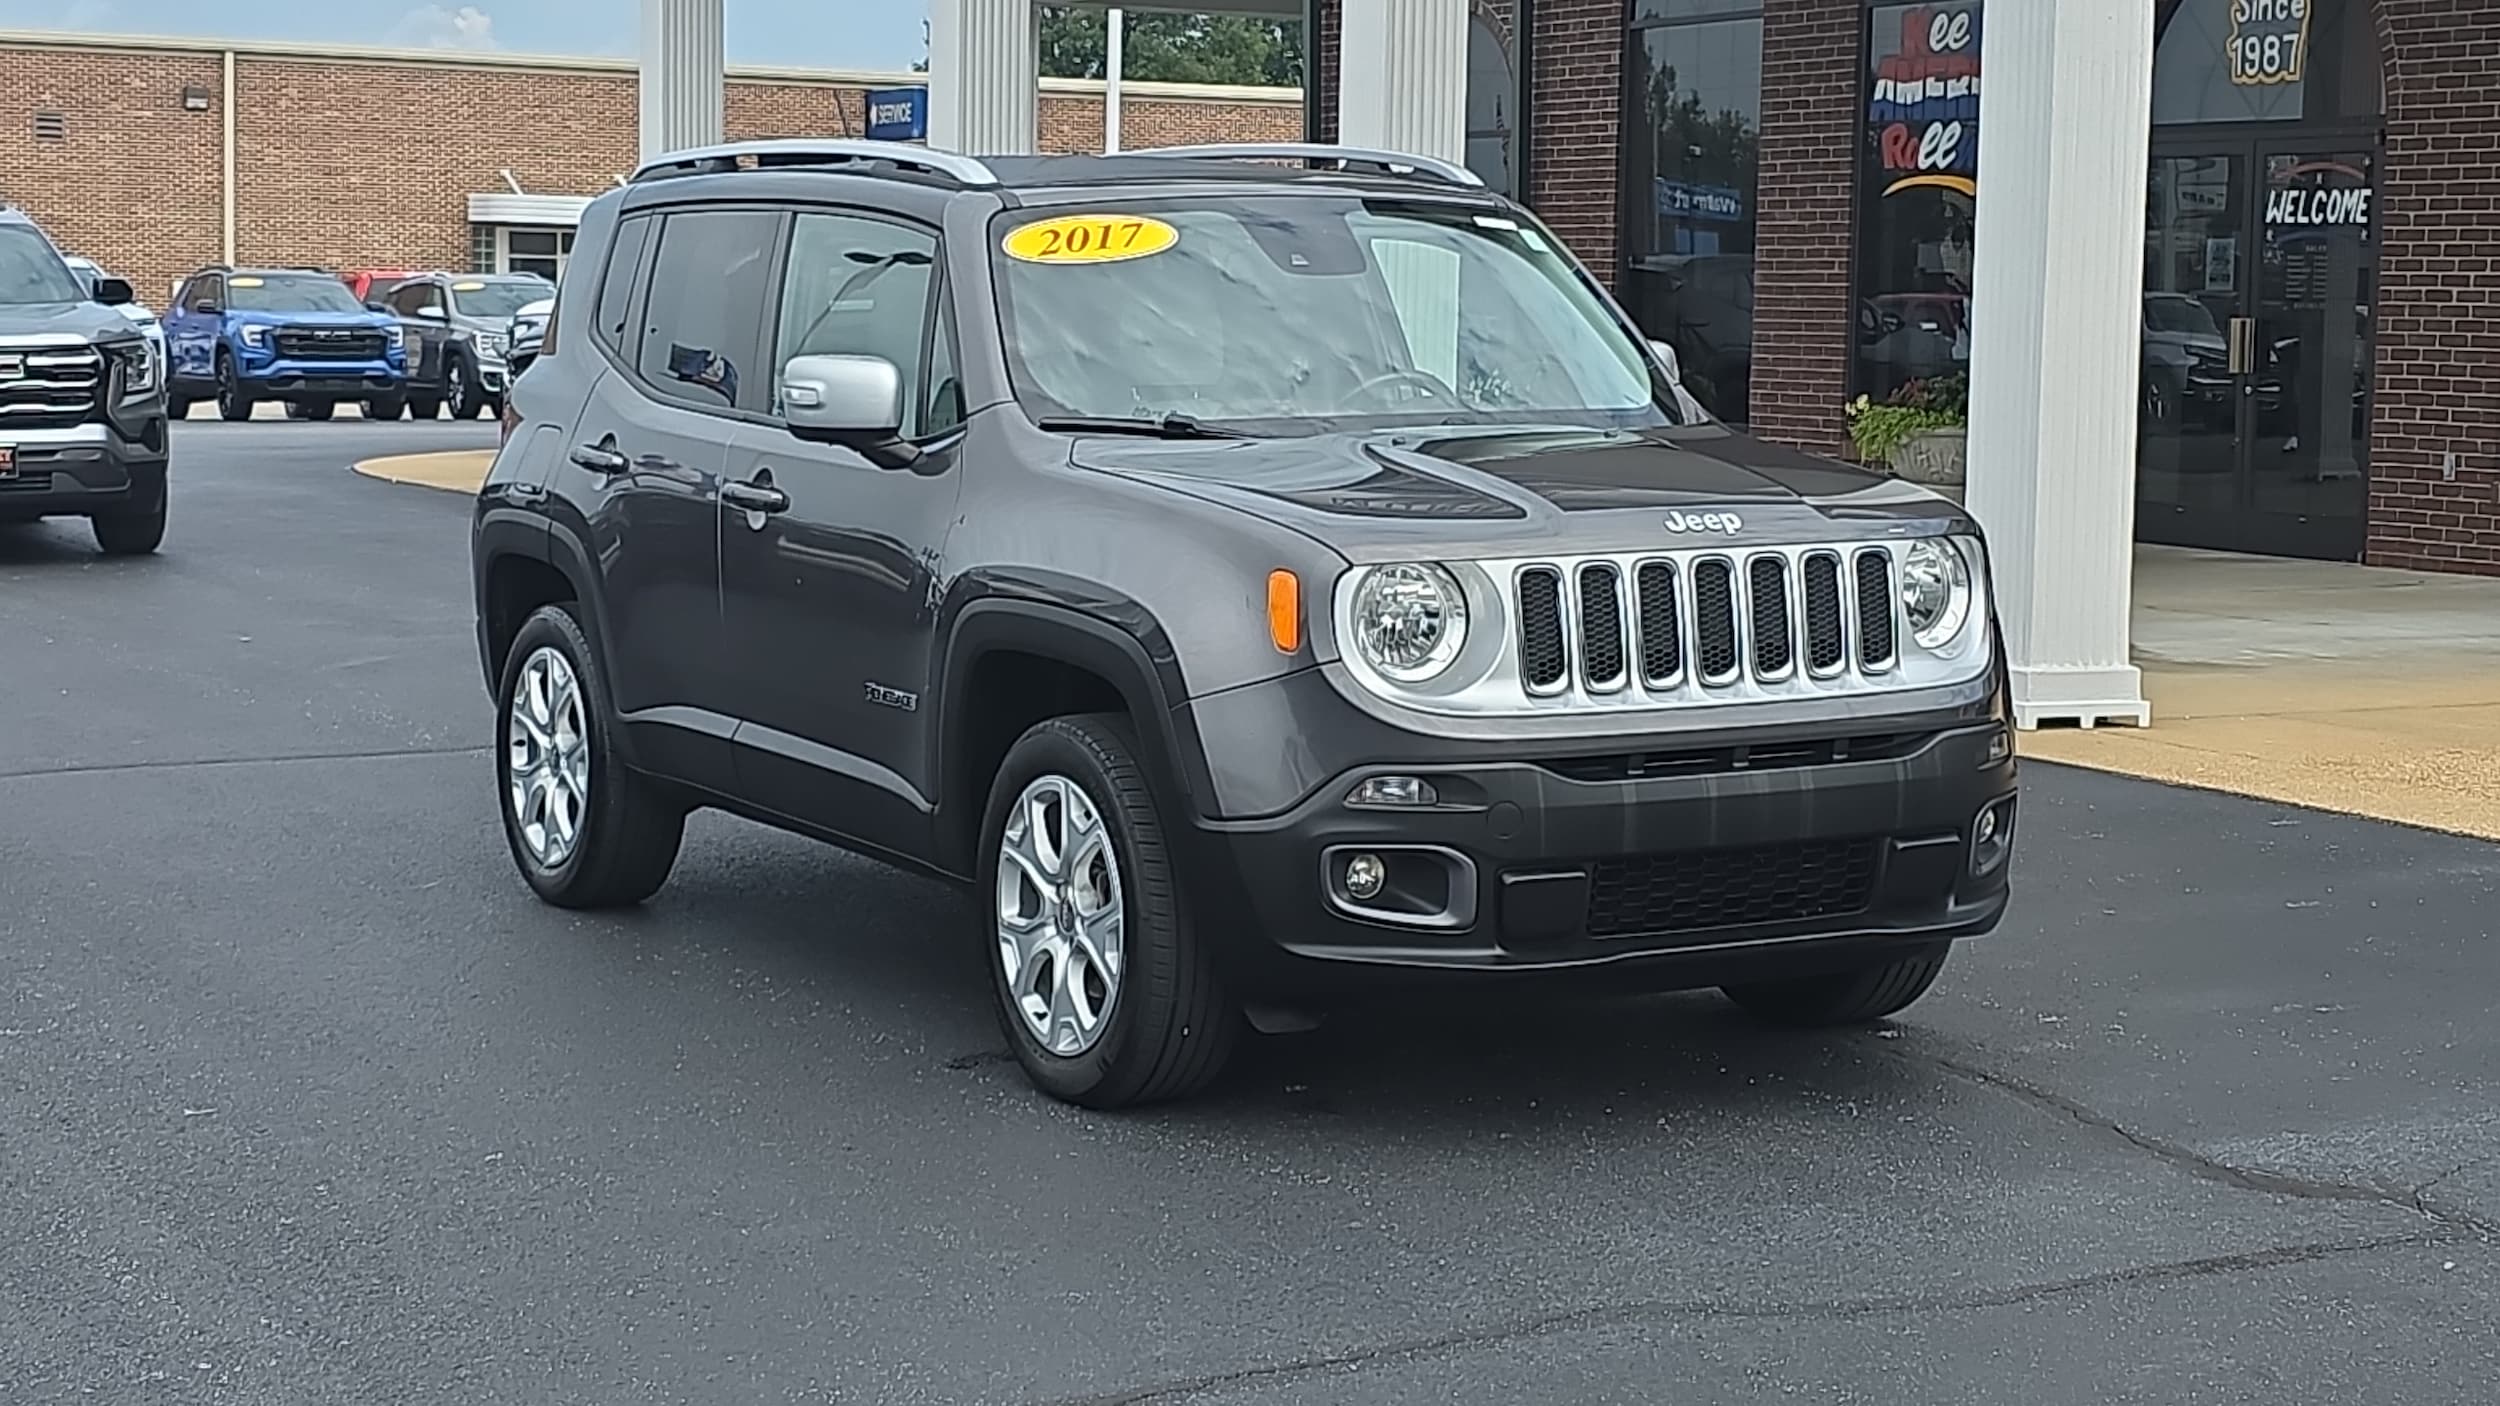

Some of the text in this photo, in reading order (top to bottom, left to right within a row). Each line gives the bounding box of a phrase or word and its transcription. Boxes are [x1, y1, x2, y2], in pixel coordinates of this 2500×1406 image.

[2235, 0, 2305, 23] Since
[2231, 33, 2300, 77] 1987
[2265, 187, 2373, 225] WELCOME
[1037, 222, 1143, 257] 2017
[1663, 510, 1743, 535] Jeep
